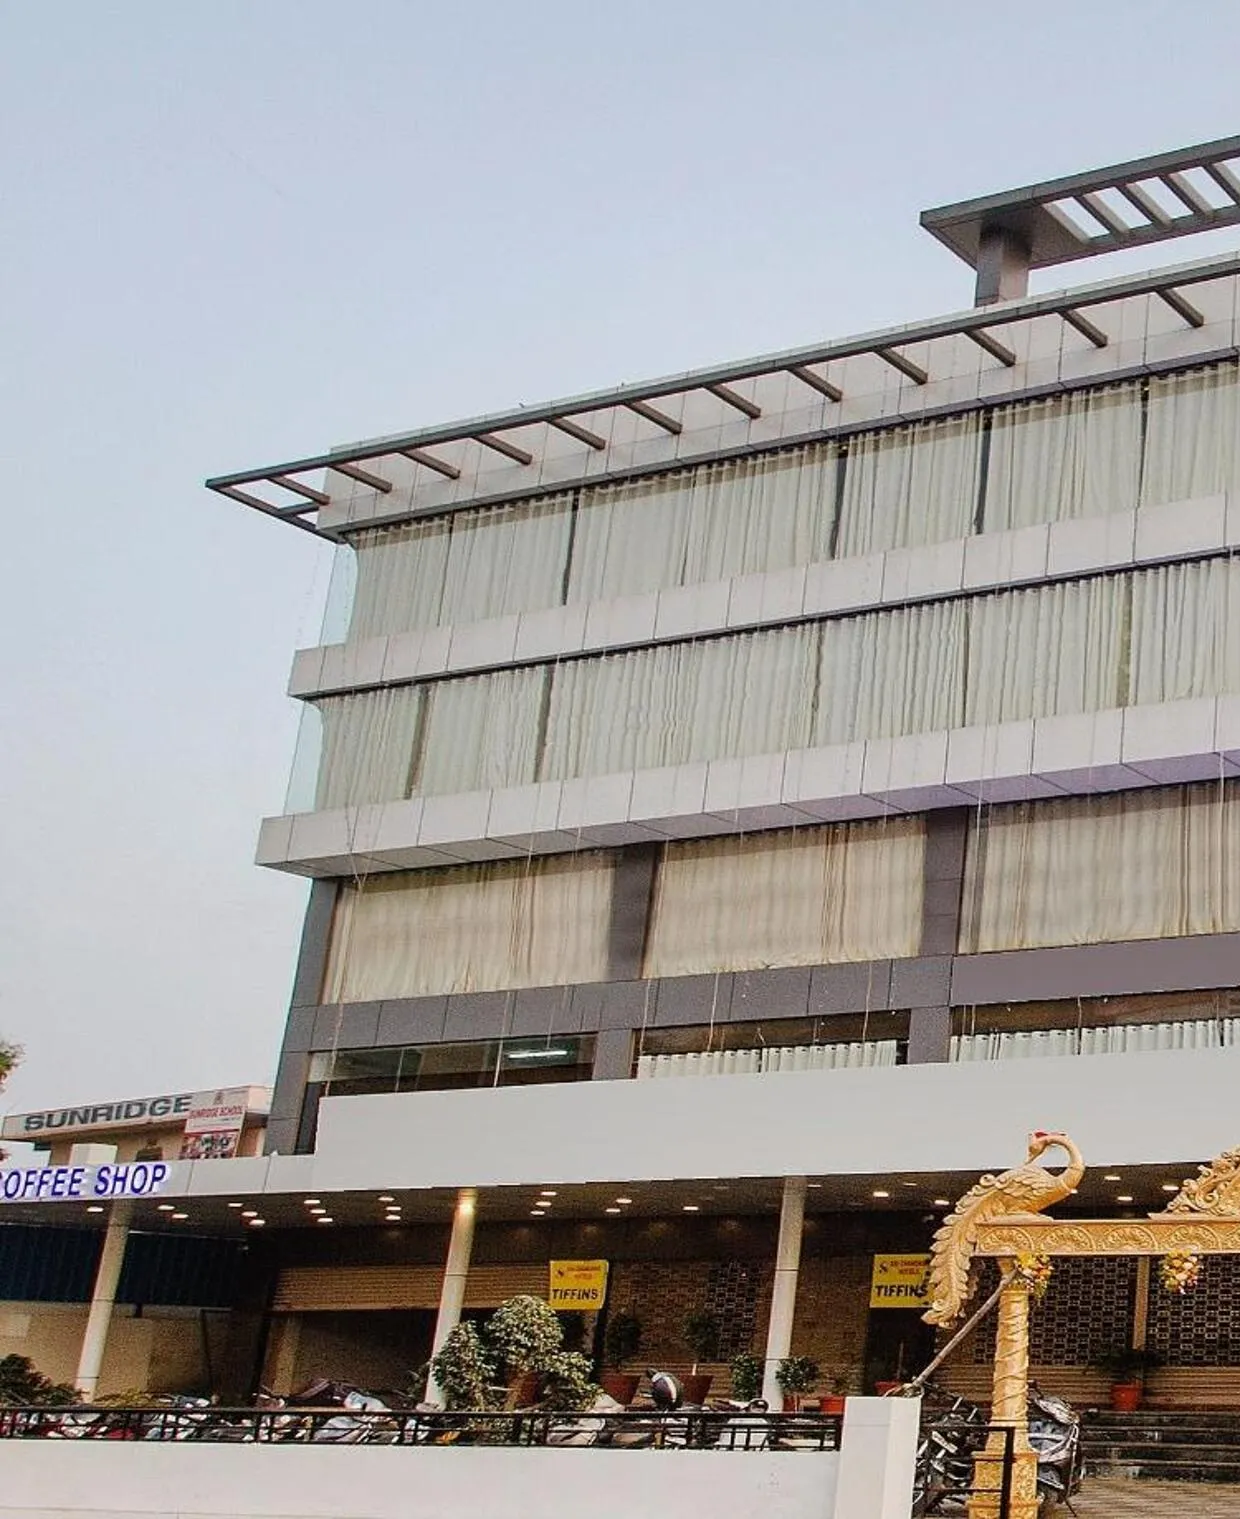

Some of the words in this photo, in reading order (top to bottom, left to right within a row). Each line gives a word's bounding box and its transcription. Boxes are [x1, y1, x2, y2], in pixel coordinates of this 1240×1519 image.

[24, 1095, 193, 1131] SUNRIDGE
[0, 1168, 85, 1199] OFFEE
[94, 1164, 167, 1195] SHOP
[552, 1288, 599, 1300] TIFFINS
[875, 1284, 929, 1298] TIFFINS
